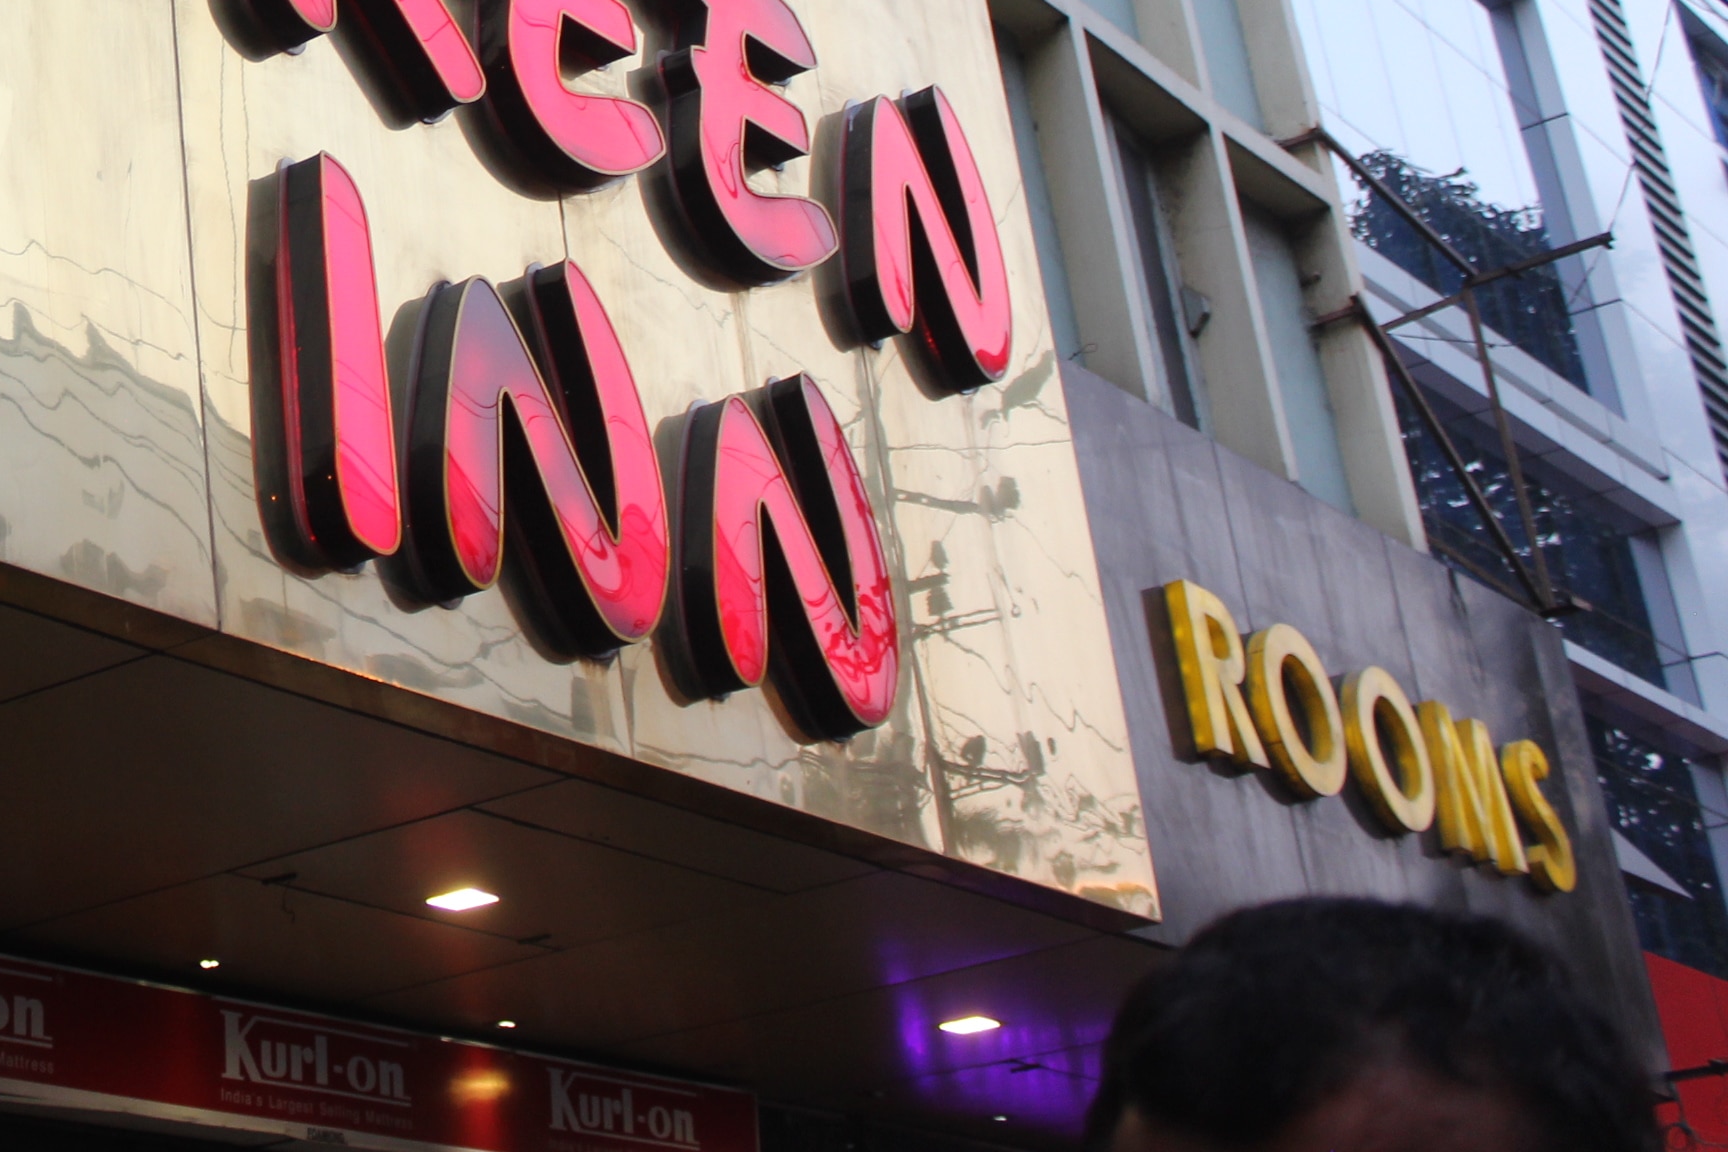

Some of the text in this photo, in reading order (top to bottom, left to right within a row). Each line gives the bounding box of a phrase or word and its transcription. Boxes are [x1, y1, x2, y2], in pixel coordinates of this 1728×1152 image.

[247, 151, 898, 743] INN
[1164, 579, 1577, 893] ROOMS
[220, 1009, 412, 1106] Kurl-on
[546, 1067, 701, 1149] Kurl-on
